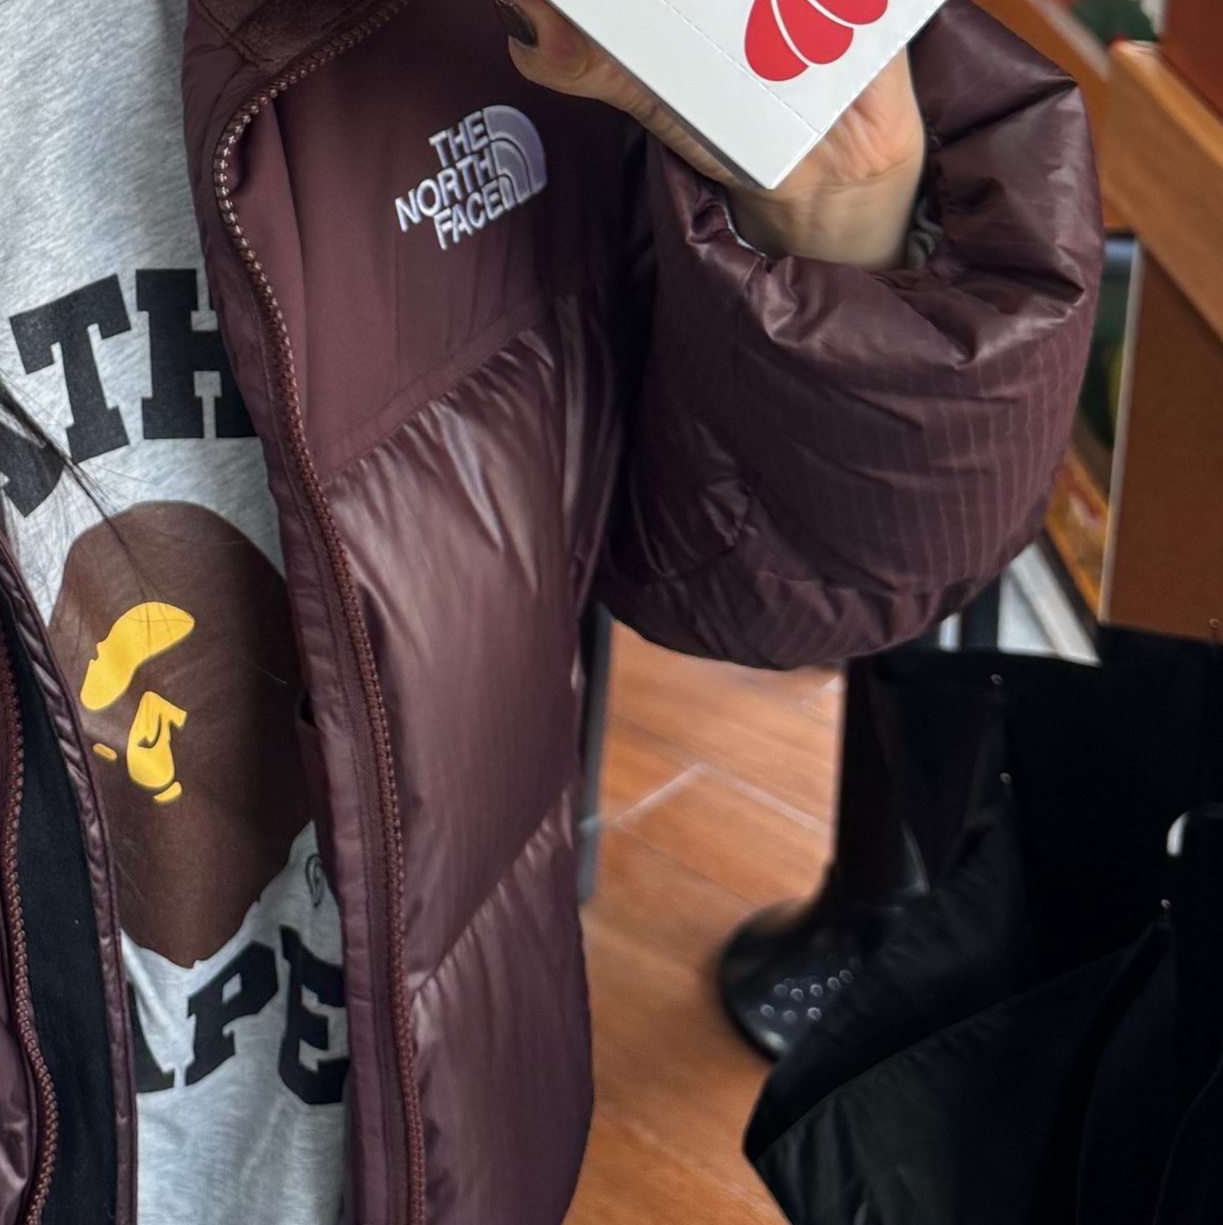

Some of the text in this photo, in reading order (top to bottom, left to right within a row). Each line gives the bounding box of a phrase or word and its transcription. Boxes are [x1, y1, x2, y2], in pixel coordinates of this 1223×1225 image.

[429, 111, 490, 168] THE
[395, 147, 498, 233] NORTH
[433, 181, 505, 251] FACE
